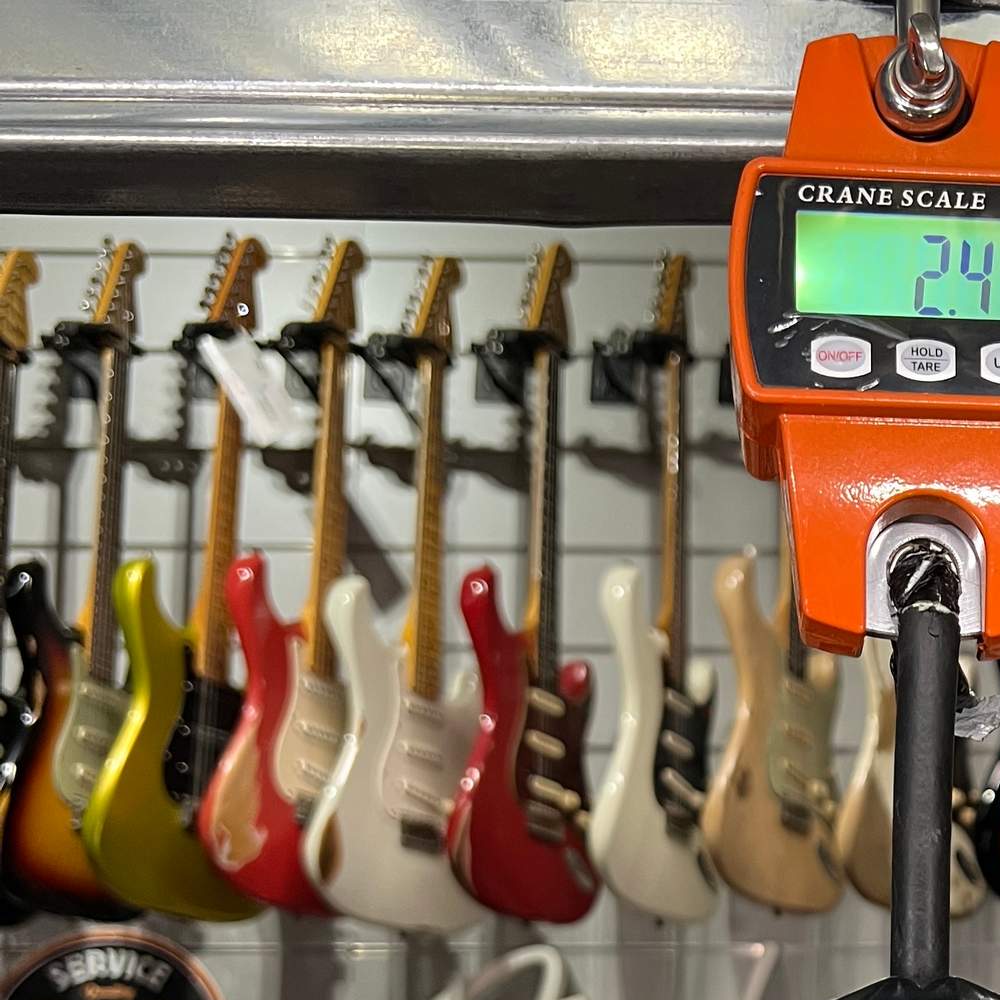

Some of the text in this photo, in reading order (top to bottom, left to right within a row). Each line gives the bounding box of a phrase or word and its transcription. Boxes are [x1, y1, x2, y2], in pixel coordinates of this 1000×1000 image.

[797, 184, 987, 211] CRANE SCALE
[817, 349, 864, 363] ON/OFF
[910, 346, 944, 358] HOLD
[910, 361, 942, 373] TARE
[50, 947, 174, 992] SERVICE
